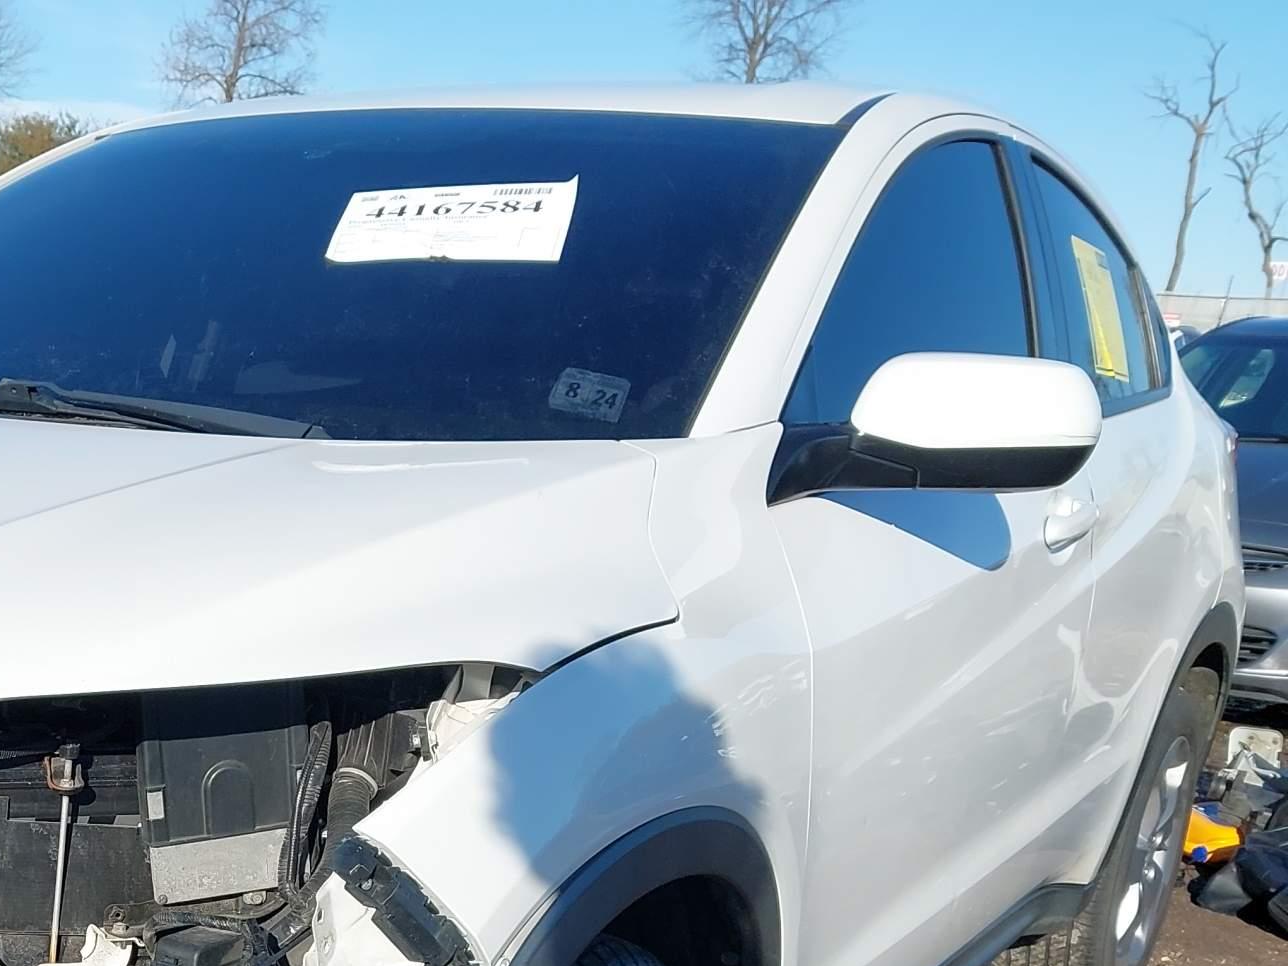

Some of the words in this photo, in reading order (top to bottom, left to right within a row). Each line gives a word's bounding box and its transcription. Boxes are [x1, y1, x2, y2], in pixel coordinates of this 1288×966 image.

[366, 199, 544, 218] 44167584
[564, 382, 581, 399] 8
[591, 389, 619, 409] 24
